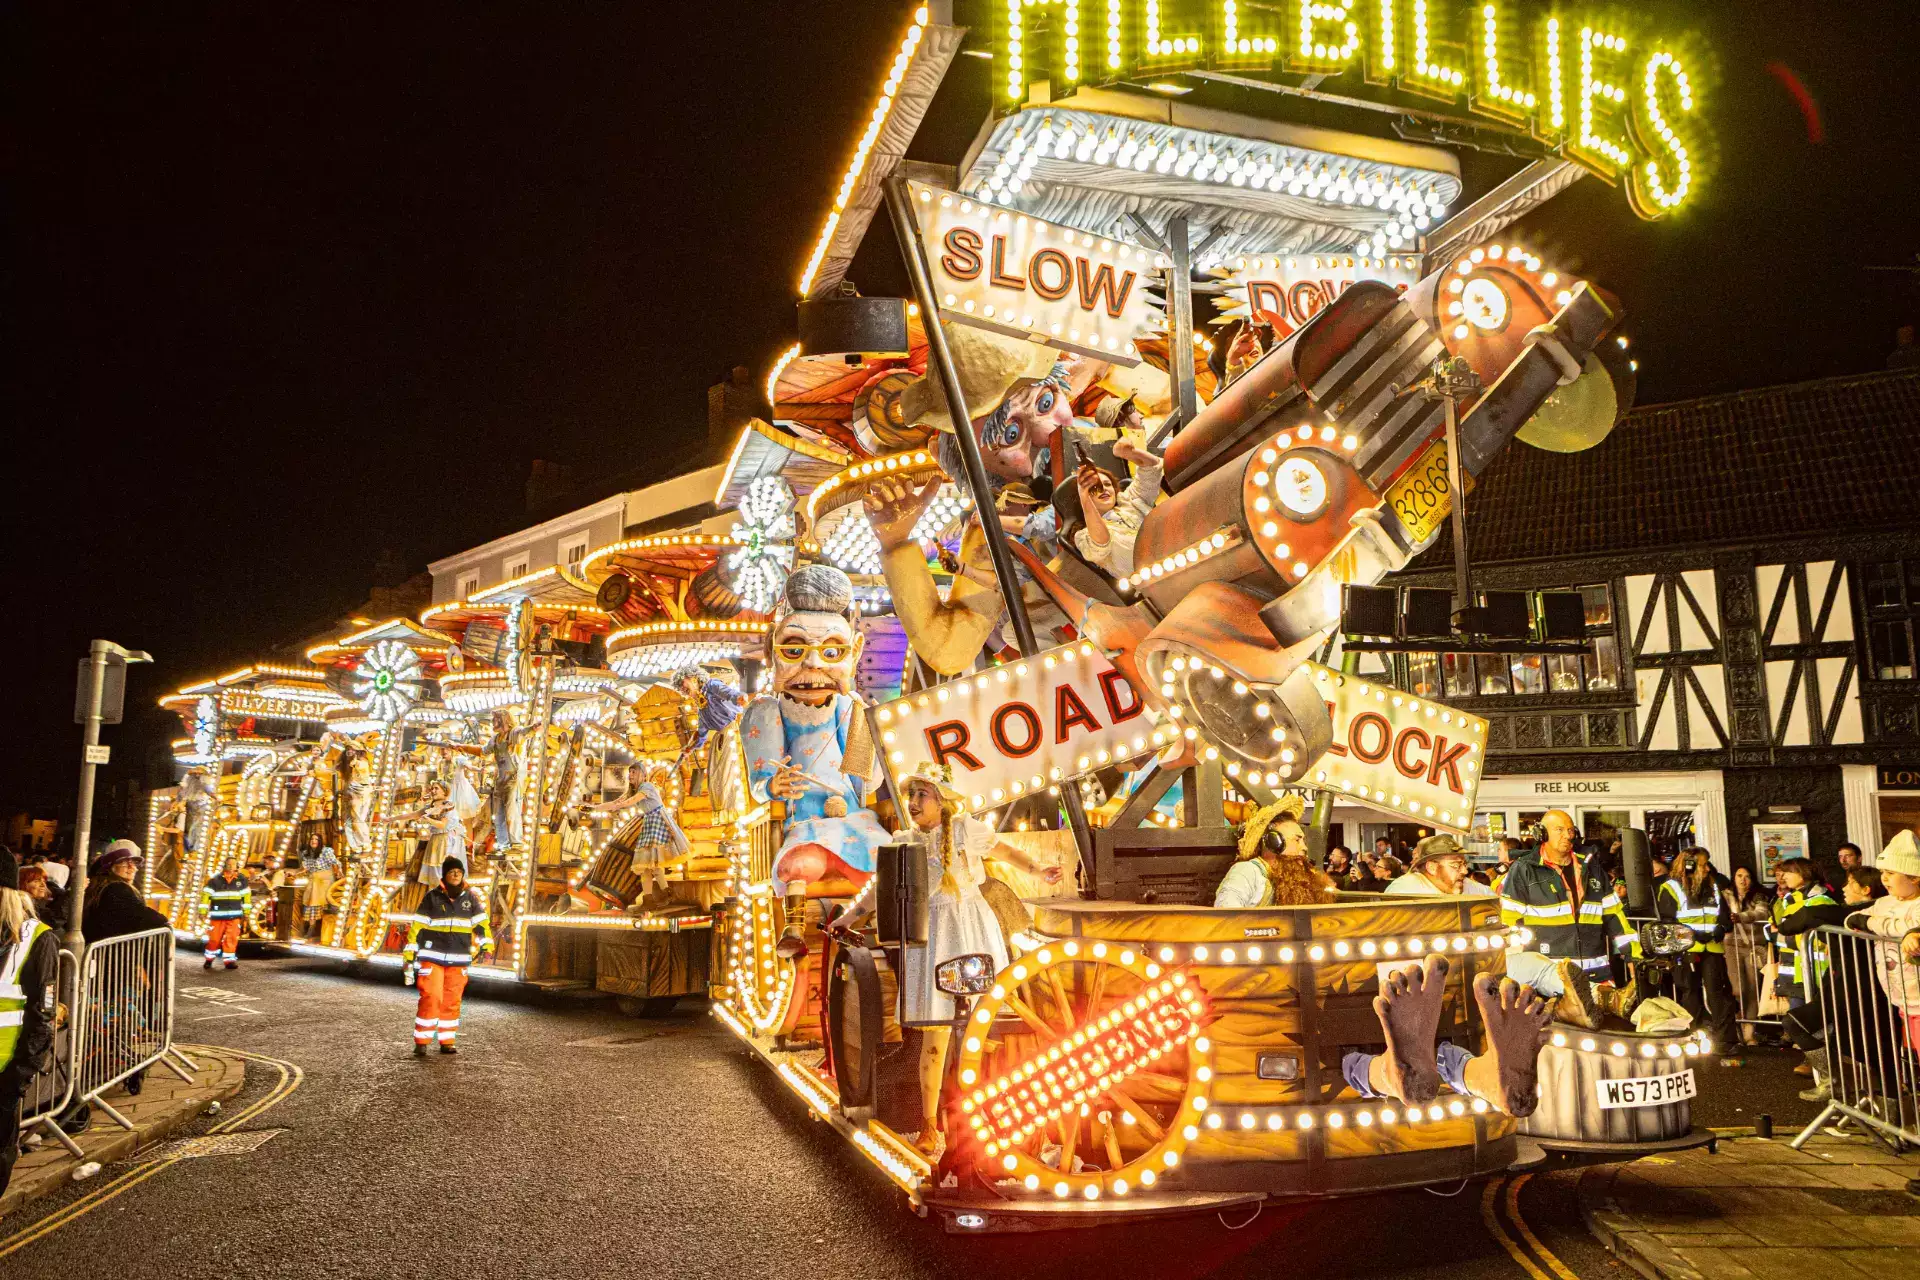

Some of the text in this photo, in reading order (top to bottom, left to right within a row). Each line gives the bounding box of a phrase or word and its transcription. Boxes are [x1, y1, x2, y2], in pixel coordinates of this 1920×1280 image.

[941, 226, 1137, 318] SLOW
[1395, 450, 1449, 525] 328-68
[1439, 495, 1453, 512] VIRG
[226, 695, 325, 717] SILVER DOL
[923, 669, 1146, 772] ROAD
[1325, 700, 1472, 795] LOCK
[1534, 781, 1611, 793] FREE HOUSE
[1606, 1073, 1692, 1104] W673 PPE
